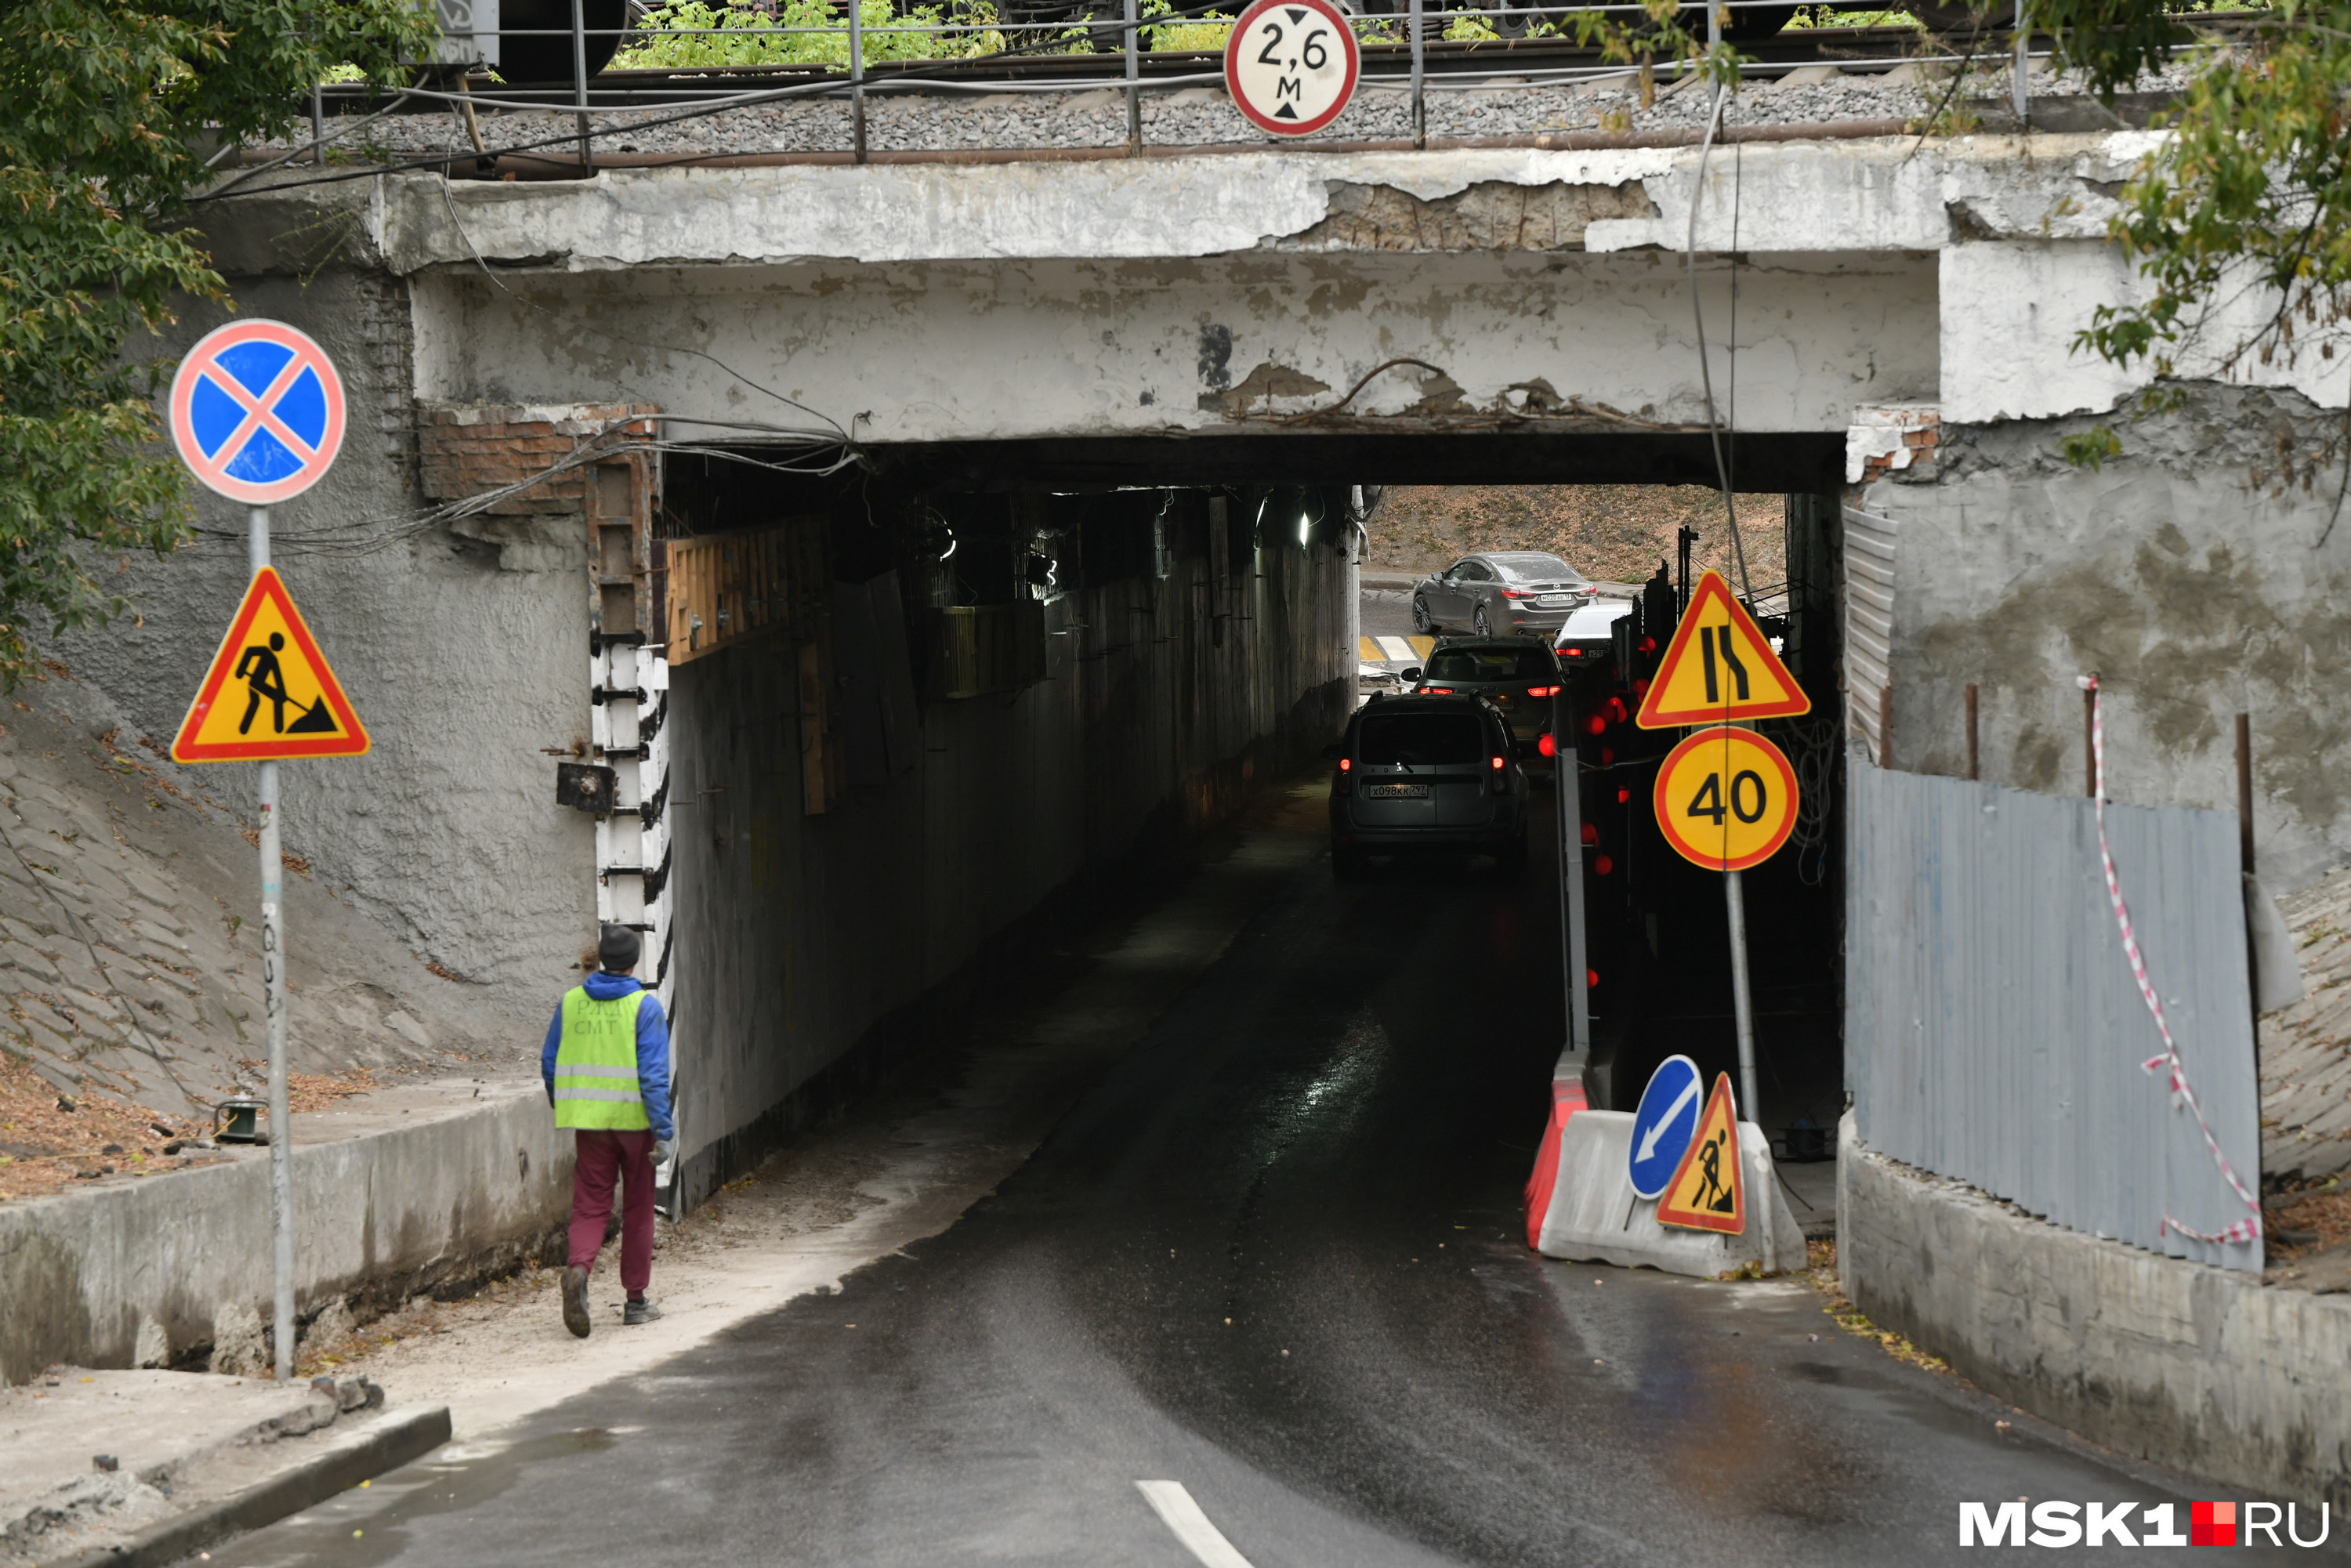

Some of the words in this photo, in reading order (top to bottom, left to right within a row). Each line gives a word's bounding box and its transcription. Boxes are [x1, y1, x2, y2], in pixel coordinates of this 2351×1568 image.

[1257, 23, 1328, 73] 2,6
[1373, 786, 1409, 796] Х098КК
[1687, 769, 1766, 826] 40
[577, 999, 622, 1017] РЖД
[574, 1019, 618, 1035] СМТ
